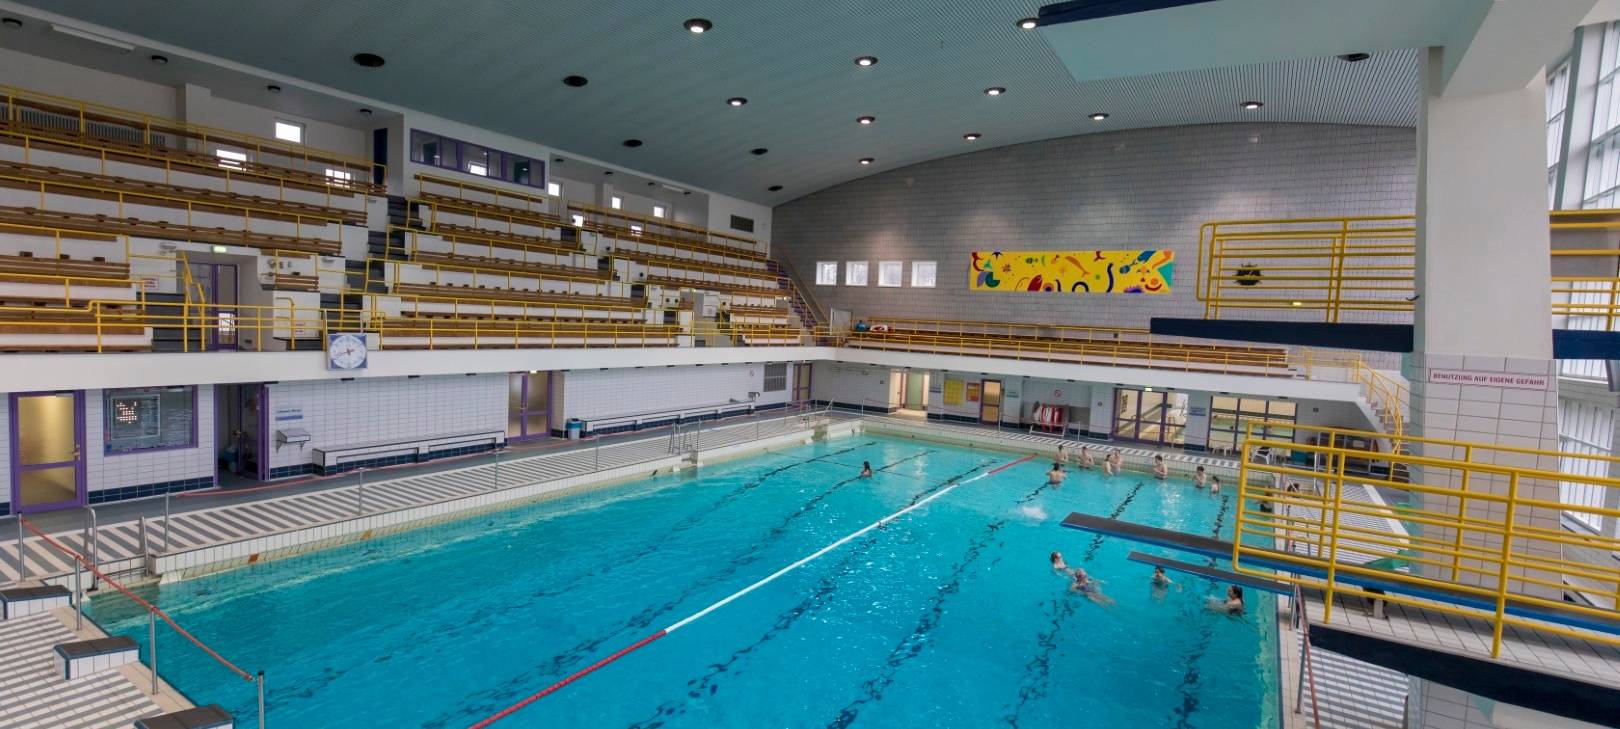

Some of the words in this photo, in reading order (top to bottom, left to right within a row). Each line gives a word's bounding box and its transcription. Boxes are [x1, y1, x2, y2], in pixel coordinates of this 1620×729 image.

[1433, 373, 1473, 381] BENUTZUNG
[1489, 376, 1514, 384] EIGENE
[1516, 378, 1545, 386] GEFAHR
